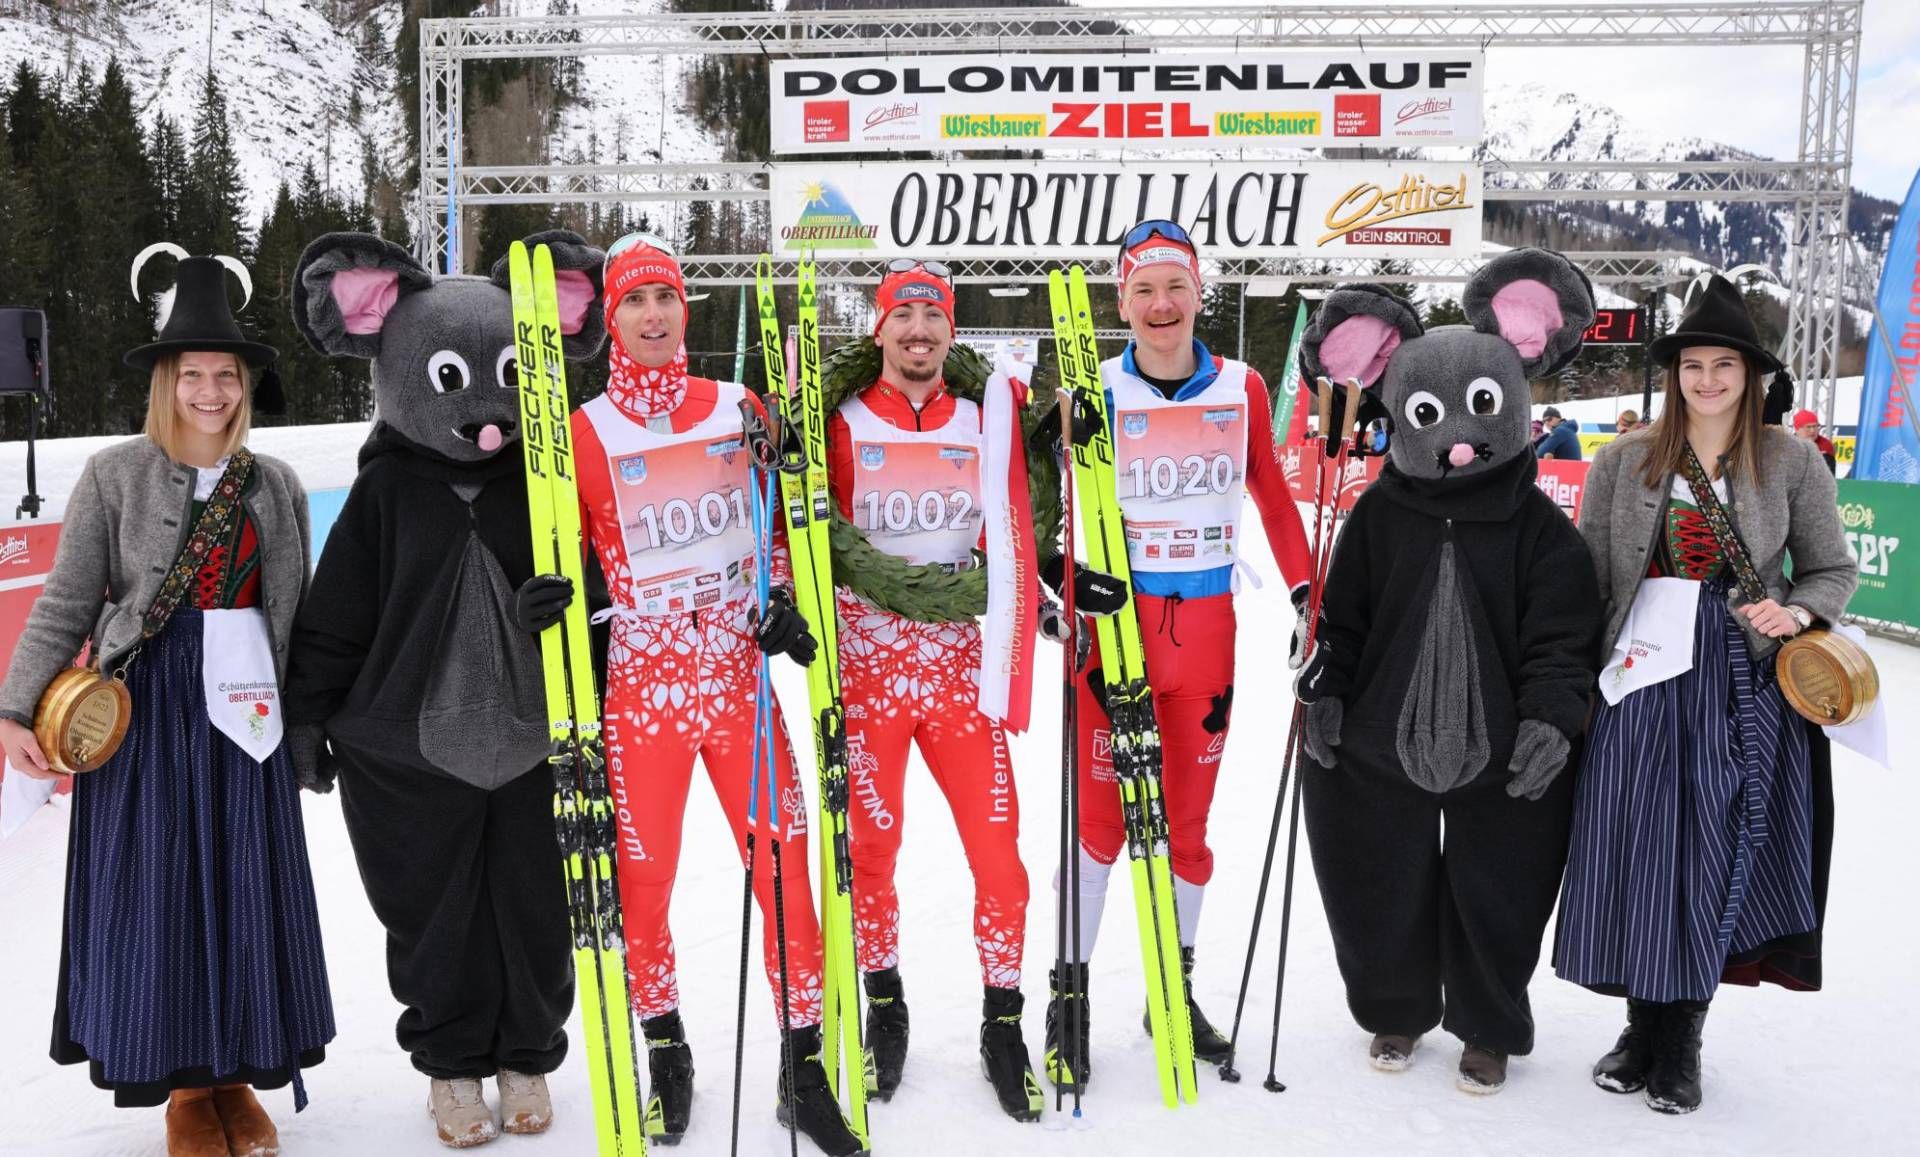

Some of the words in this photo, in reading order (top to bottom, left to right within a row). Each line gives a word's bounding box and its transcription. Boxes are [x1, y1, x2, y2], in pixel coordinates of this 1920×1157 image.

[784, 61, 1472, 97] DOLOMITENLAUF
[807, 117, 832, 125] tiroler
[807, 125, 836, 133] wasser
[945, 115, 1040, 137] Wiesbauer
[1048, 102, 1209, 138] ZIEL
[1219, 113, 1316, 135] Wiesbauer
[1337, 111, 1363, 119] tiroler
[1337, 119, 1367, 127] wasser
[1337, 126, 1357, 134] kraft
[807, 132, 827, 140] kraft
[890, 171, 1309, 248] OBERTILLIACH
[1322, 172, 1470, 230] Osttirol
[781, 225, 878, 240] OBERTILLIACH
[615, 264, 677, 289] Internorm
[518, 321, 547, 479] FISCHER
[541, 324, 572, 481] FISCHER
[803, 318, 823, 467] FISCHER
[1079, 333, 1112, 466] FIHER
[1129, 453, 1234, 498] 1020
[1534, 475, 1580, 506] ffler
[638, 487, 748, 549] 1001
[863, 489, 973, 531] 1002
[0, 532, 29, 560] sttirol
[1844, 531, 1900, 577] ser
[605, 713, 647, 862] Internorm
[846, 730, 894, 830] TRENTINO
[988, 719, 1008, 822] Internor
